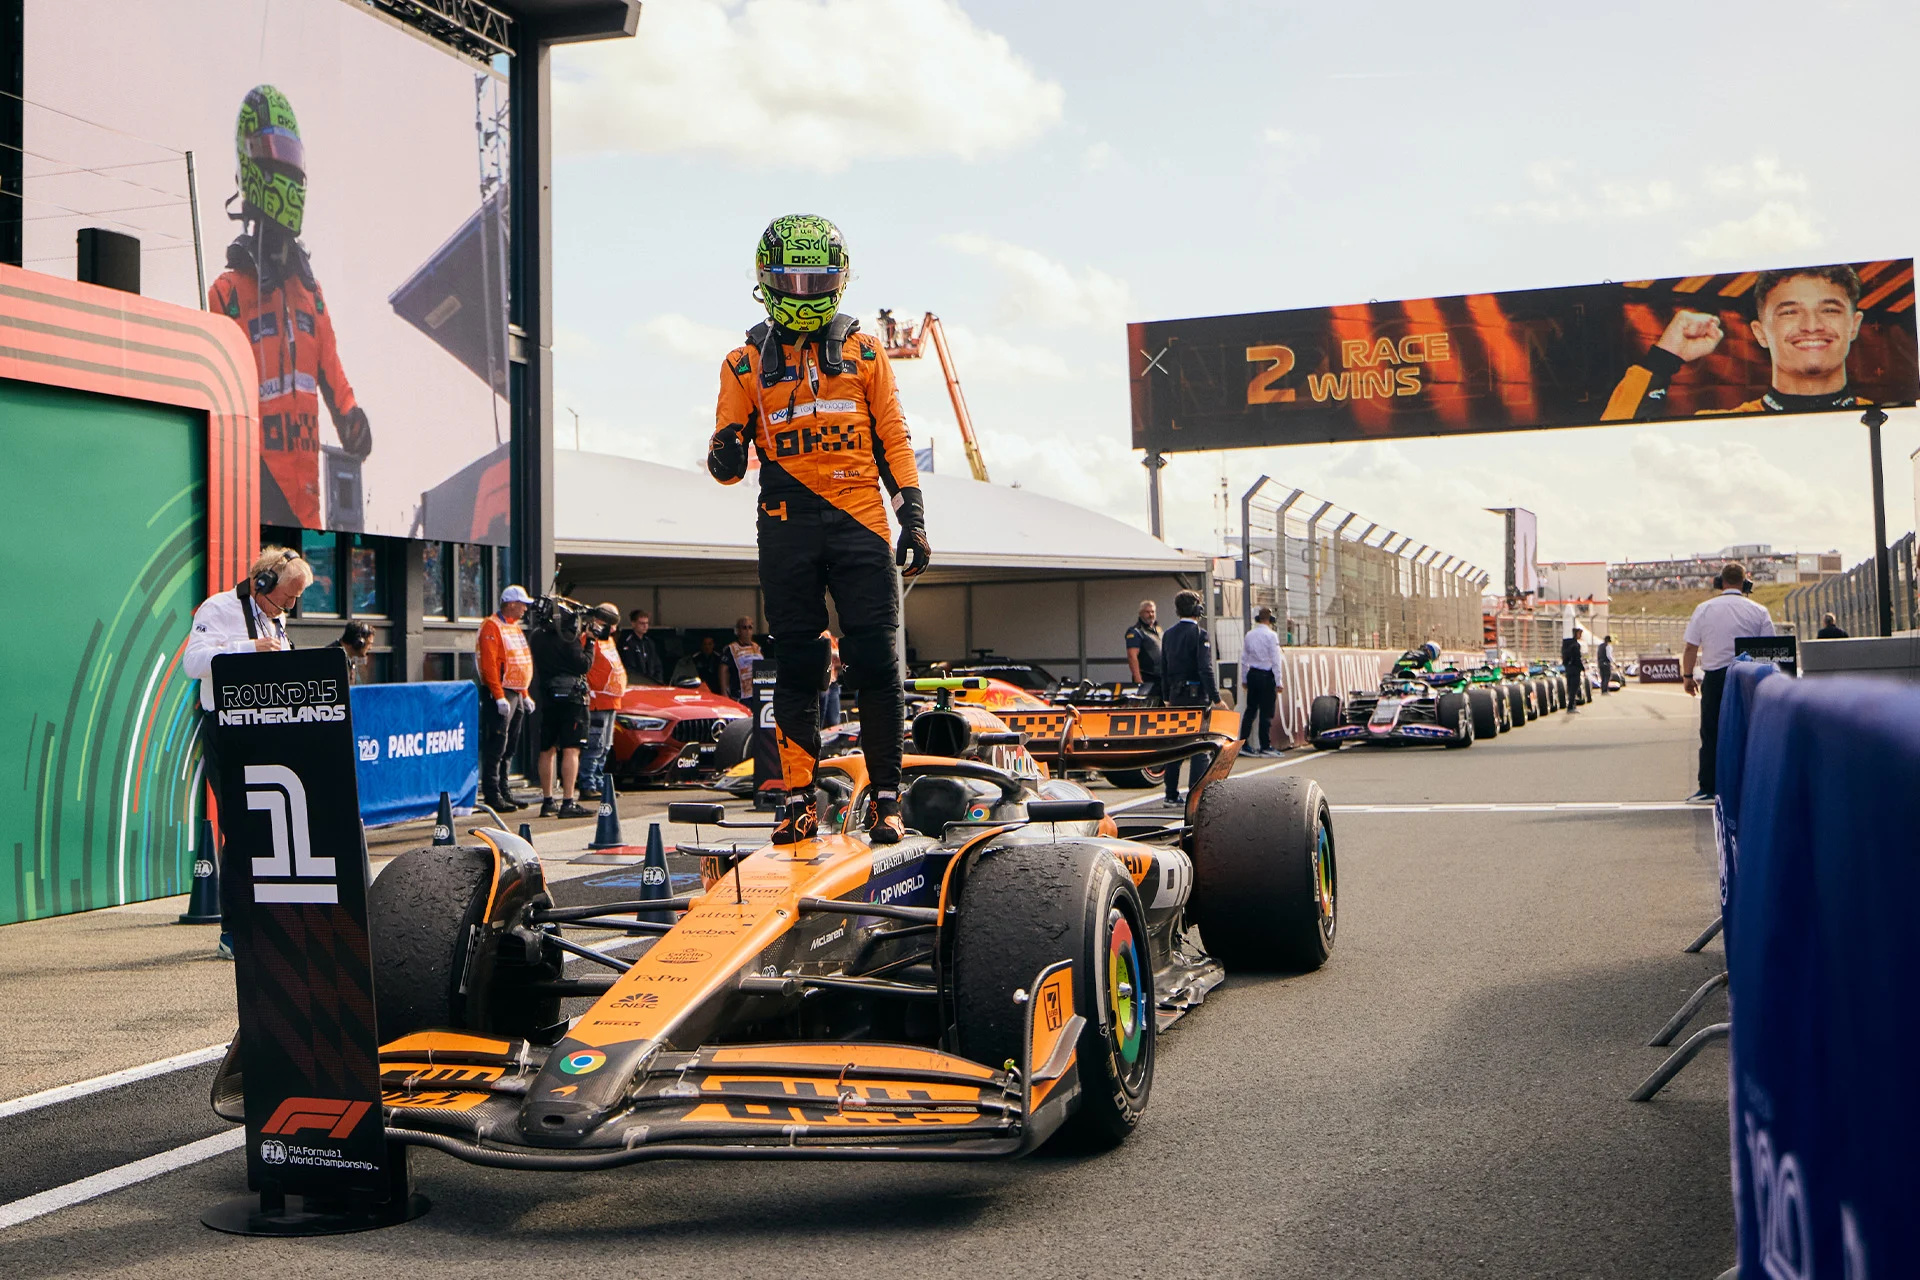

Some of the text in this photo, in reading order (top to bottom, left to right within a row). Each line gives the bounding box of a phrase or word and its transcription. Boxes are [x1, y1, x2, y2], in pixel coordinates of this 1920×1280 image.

[791, 255, 821, 264] OKX
[1246, 345, 1296, 405] 2
[1341, 332, 1450, 369] RACE
[1307, 367, 1422, 402] WINS
[775, 424, 855, 458] OKX
[761, 501, 788, 521] 4
[1642, 664, 1678, 675] QATAR
[1650, 671, 1680, 680] AIRWAYS
[222, 679, 338, 708] ROUND 15
[218, 704, 346, 727] NETHERLANDS
[1108, 711, 1198, 737] OKX
[388, 732, 424, 759] PARC
[426, 721, 465, 755] FERMÉ
[677, 757, 697, 769] Claro
[244, 764, 336, 878] 1
[872, 846, 926, 876] RICHARD MILLE
[642, 867, 665, 885] FIA
[725, 886, 780, 894] Hilton
[880, 887, 892, 905] DP
[893, 874, 925, 899] WORLD
[695, 910, 757, 920] alteryx
[681, 928, 739, 936] webex
[809, 927, 845, 952] McLaren
[633, 974, 688, 983] FxPro
[1047, 991, 1057, 1009] 7
[260, 1096, 374, 1139] F1
[289, 1146, 342, 1158] FIA Formula 1
[289, 1156, 313, 1166] World
[314, 1157, 373, 1171] Championship
